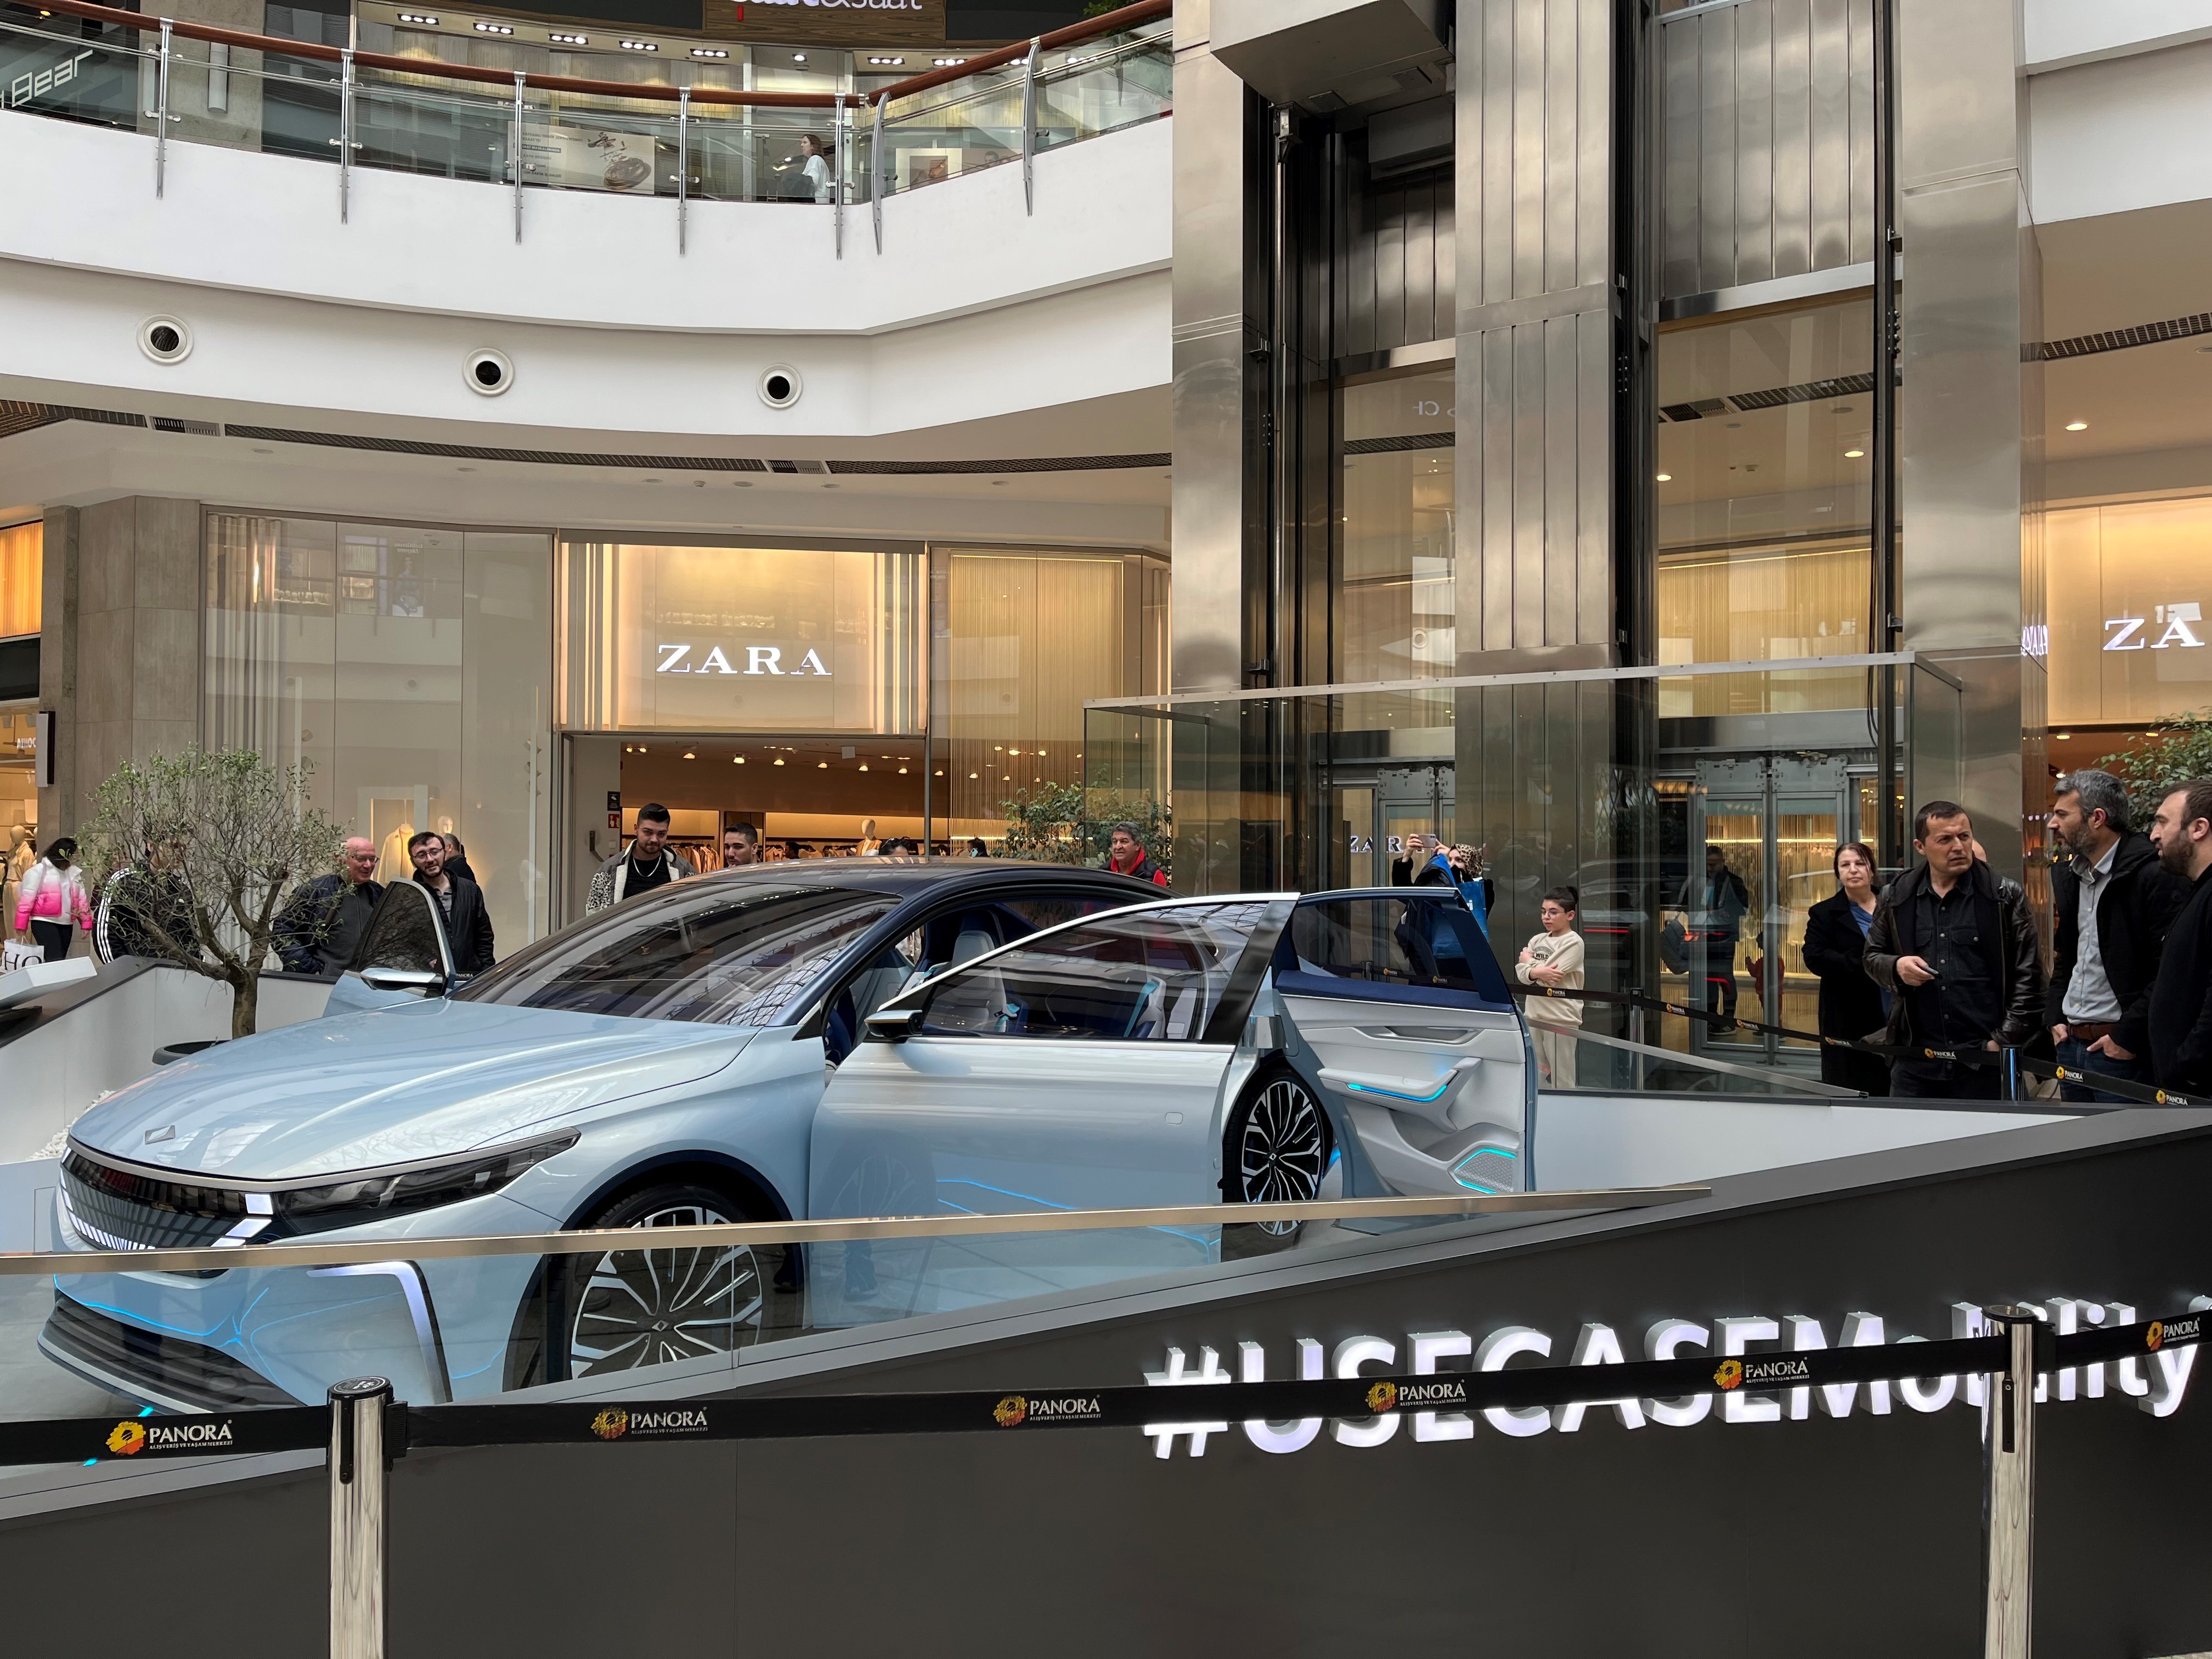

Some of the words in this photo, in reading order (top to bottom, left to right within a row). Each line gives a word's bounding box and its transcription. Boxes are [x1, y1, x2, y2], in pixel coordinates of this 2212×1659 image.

[0, 49, 93, 109] Bear
[656, 645, 832, 675] ZARA
[1350, 836, 1425, 854] ZAR
[2064, 1070, 2084, 1081] PANORA
[2166, 1094, 2188, 1106] PANORA
[2163, 1319, 2199, 1338] PANORA
[1746, 1360, 1808, 1378] PANORA
[1400, 1383, 1465, 1401] PANORA
[1029, 1398, 1101, 1415] PANORA
[631, 1410, 707, 1429] PANORA
[149, 1424, 232, 1443] PANORA
